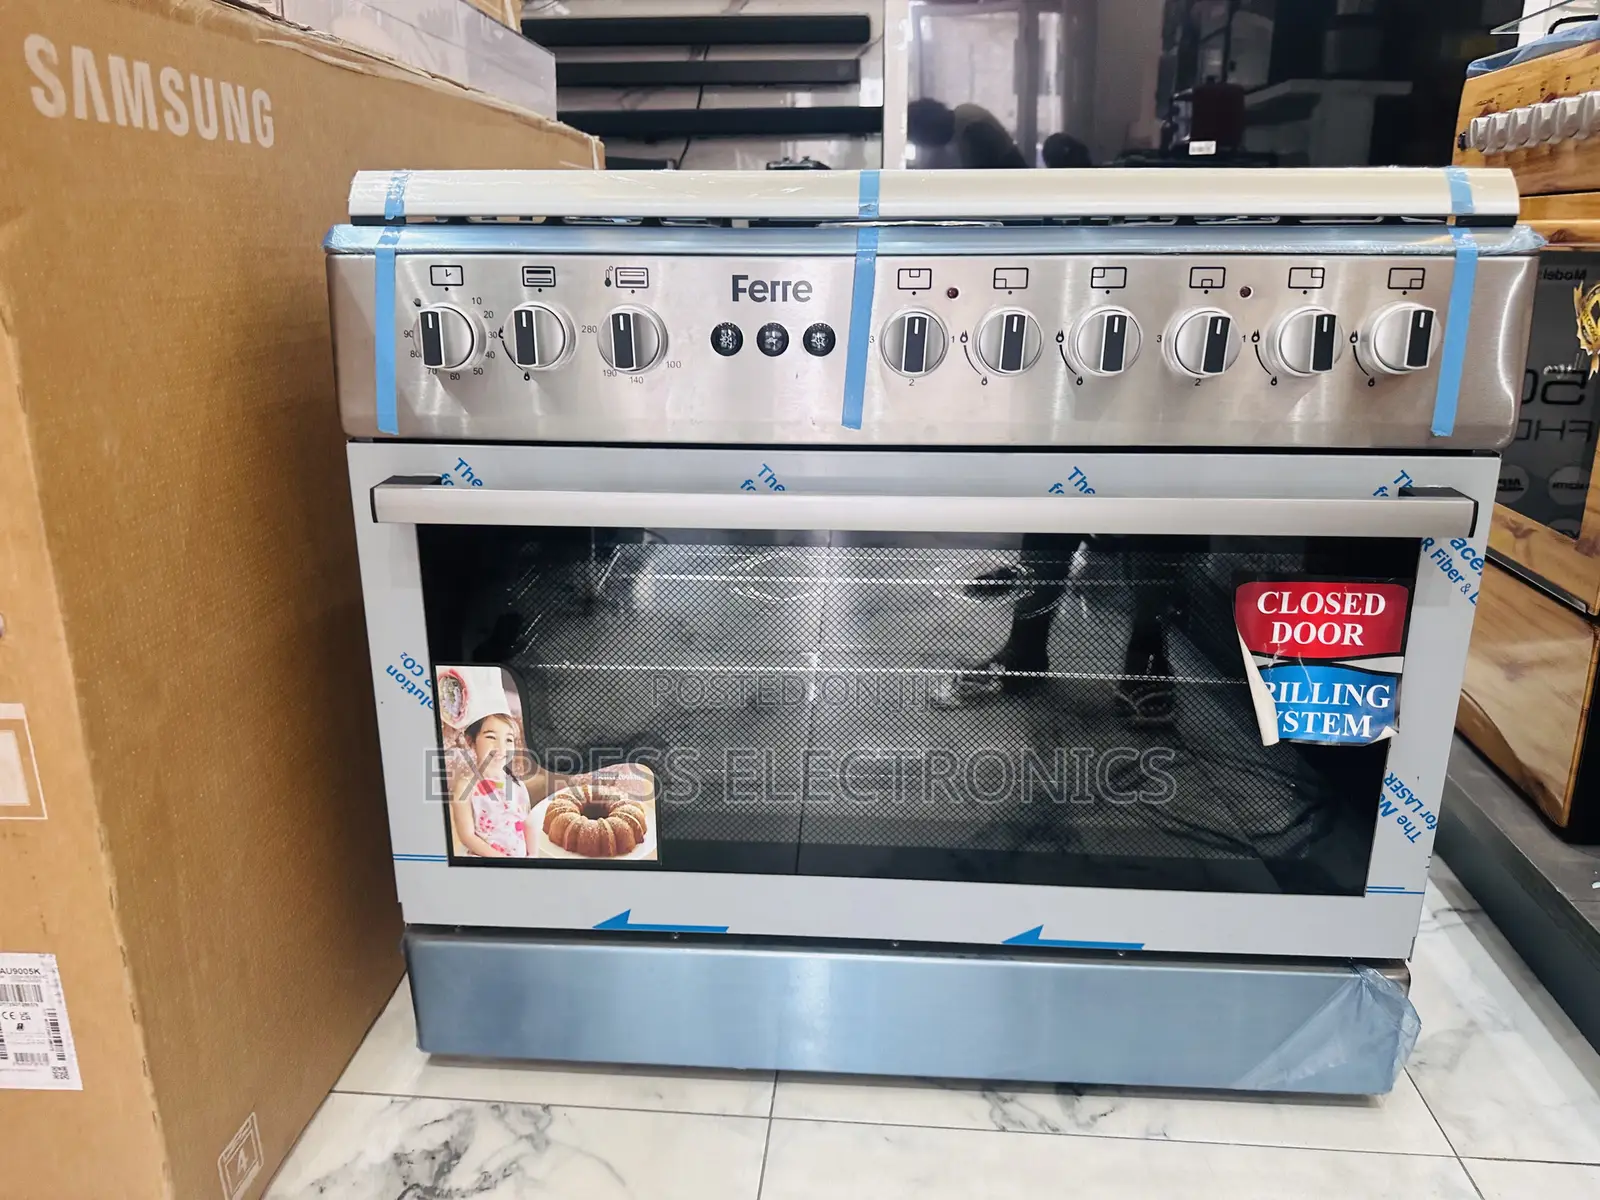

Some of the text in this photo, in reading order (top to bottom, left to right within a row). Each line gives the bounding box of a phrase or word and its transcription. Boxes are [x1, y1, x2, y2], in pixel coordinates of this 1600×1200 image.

[24, 33, 274, 148] SAMSUNG
[732, 274, 813, 303] Ferre
[472, 297, 482, 305] 10
[484, 311, 494, 319] 20
[403, 330, 414, 338] 90
[581, 325, 598, 334] 280
[869, 335, 875, 343] 3
[1156, 335, 1162, 343] 3
[410, 350, 421, 358] 80
[666, 360, 682, 369] 100
[427, 367, 438, 375] 70
[603, 369, 618, 377] 190
[630, 376, 644, 384] 140
[908, 379, 915, 387] 2
[1194, 378, 1201, 387] 2
[454, 457, 483, 486] The
[1430, 548, 1465, 583] Fiber
[1460, 583, 1471, 595] &
[1257, 591, 1386, 616] CLOSED
[1269, 621, 1364, 646] DOOR
[1384, 772, 1438, 830] for LASER
[1396, 815, 1422, 843] The
